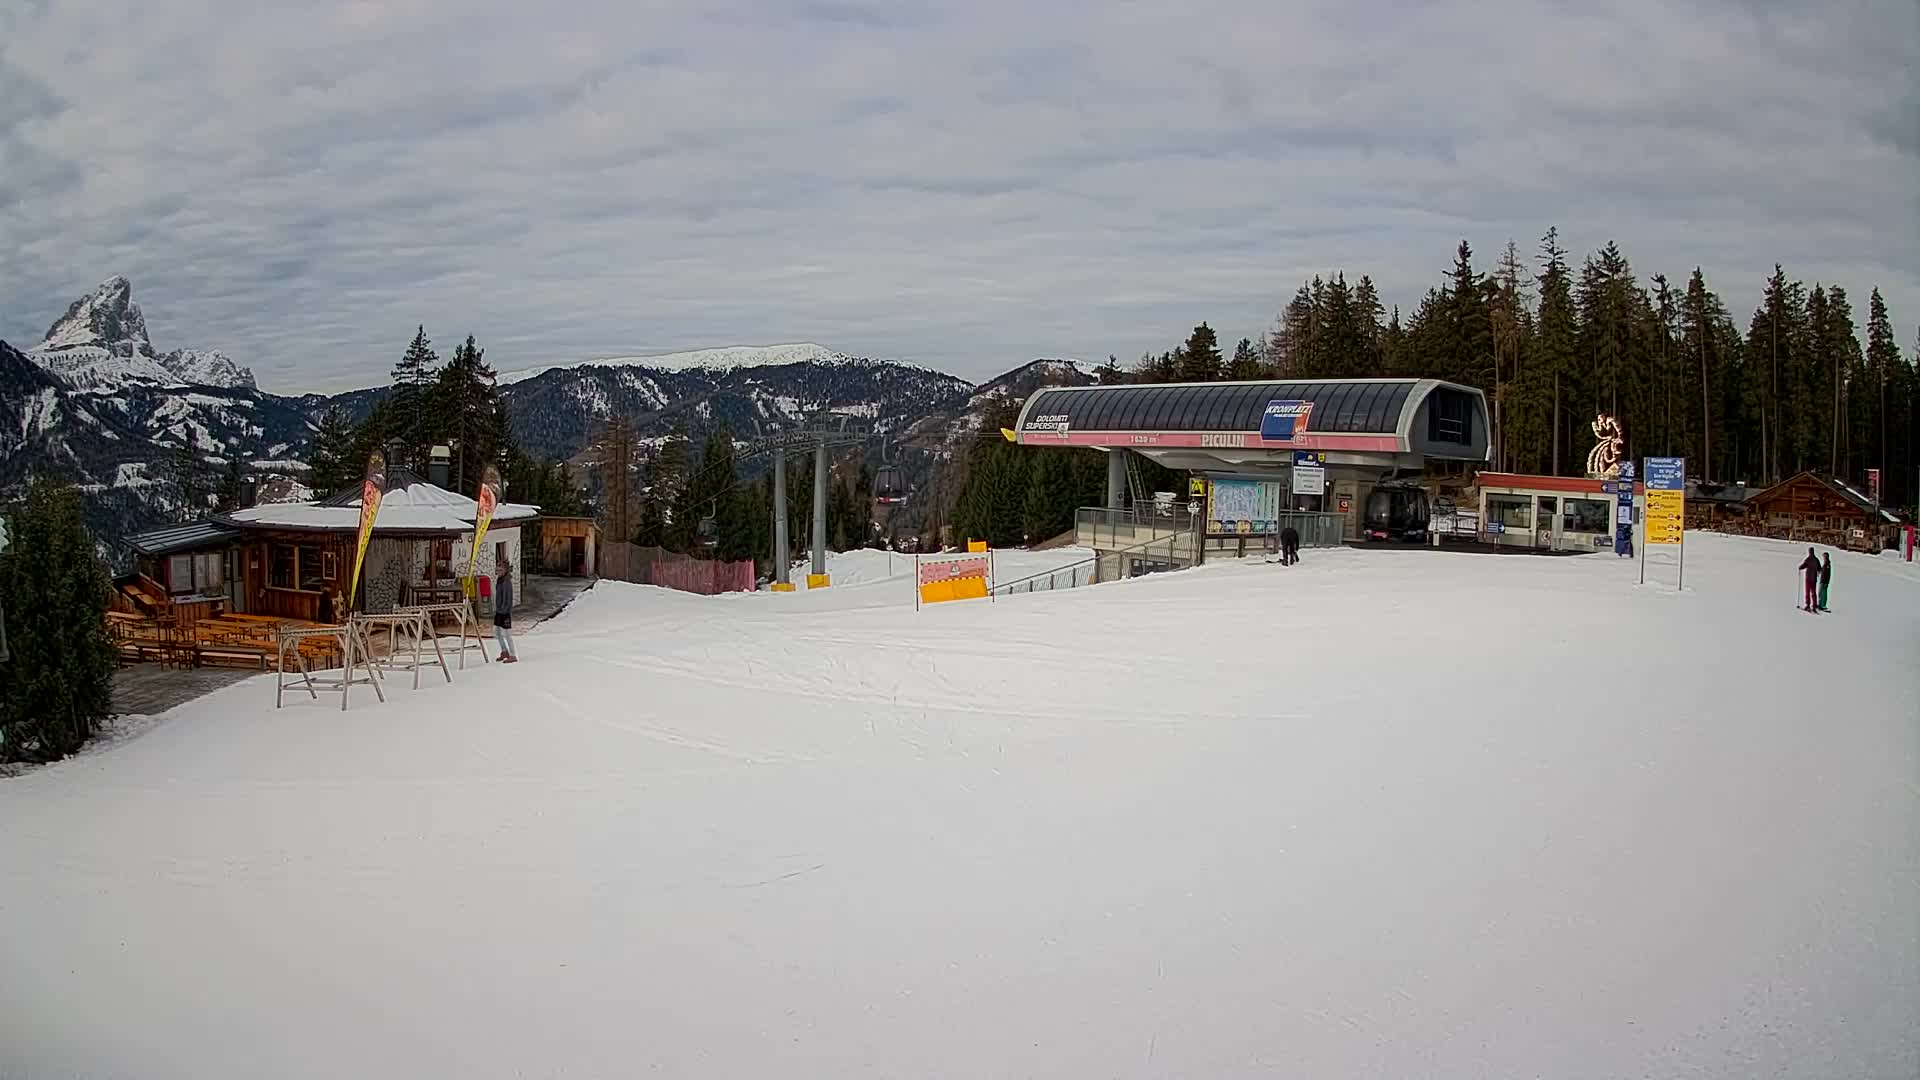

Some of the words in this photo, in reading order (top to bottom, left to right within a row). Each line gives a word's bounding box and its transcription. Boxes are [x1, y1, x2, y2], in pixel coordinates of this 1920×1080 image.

[1265, 405, 1310, 414] KRONPLATZ
[1025, 422, 1058, 430] SUPERSKI
[1201, 434, 1245, 447] PICULIN
